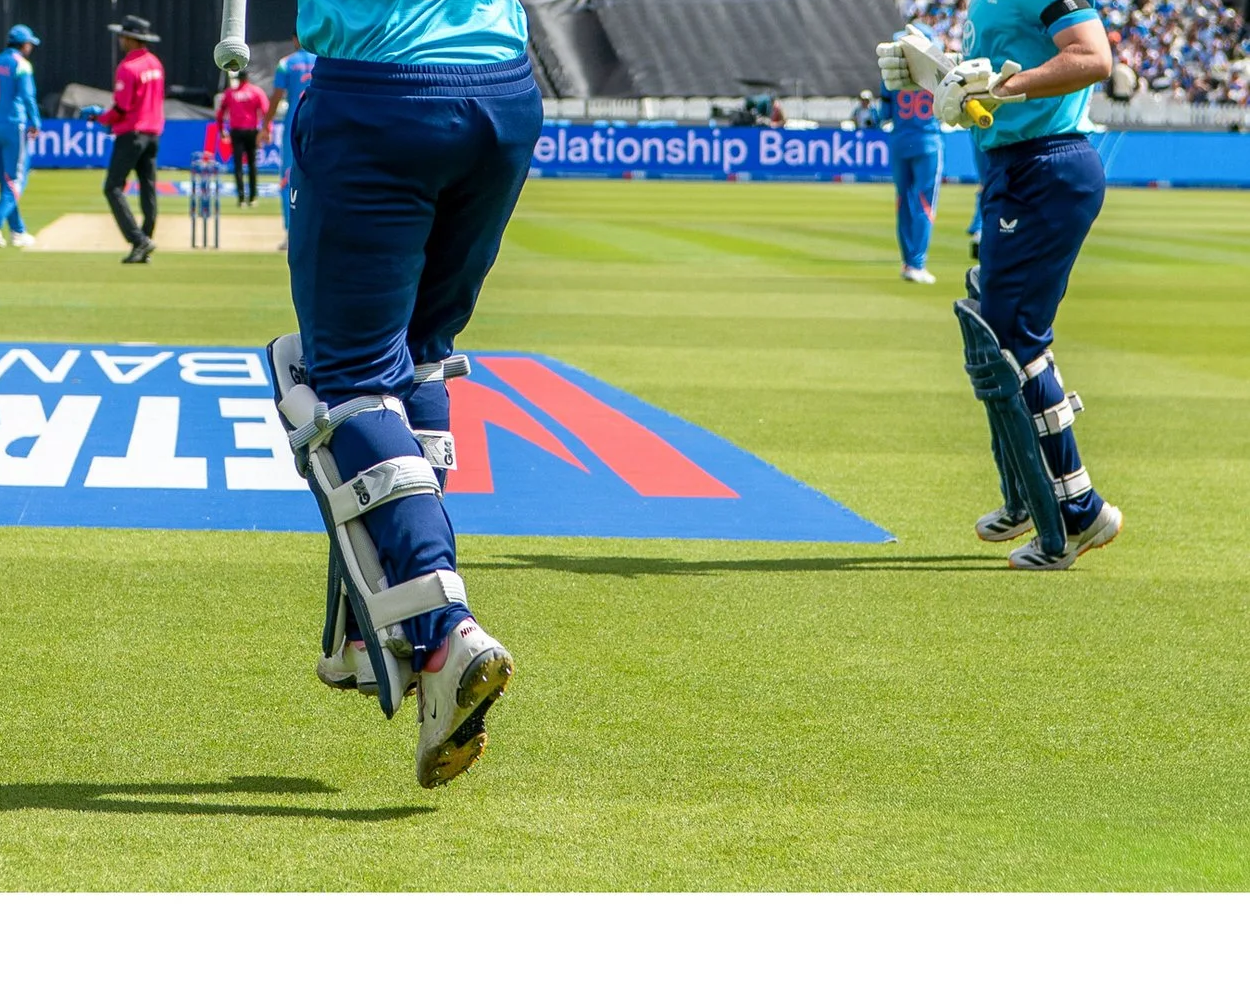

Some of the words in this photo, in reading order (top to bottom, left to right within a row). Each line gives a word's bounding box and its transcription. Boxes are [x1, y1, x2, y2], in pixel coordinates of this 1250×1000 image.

[897, 89, 934, 120] 96
[533, 129, 749, 174] elationship
[759, 130, 889, 167] Bankin
[444, 440, 454, 466] GM
[352, 478, 371, 506] GM
